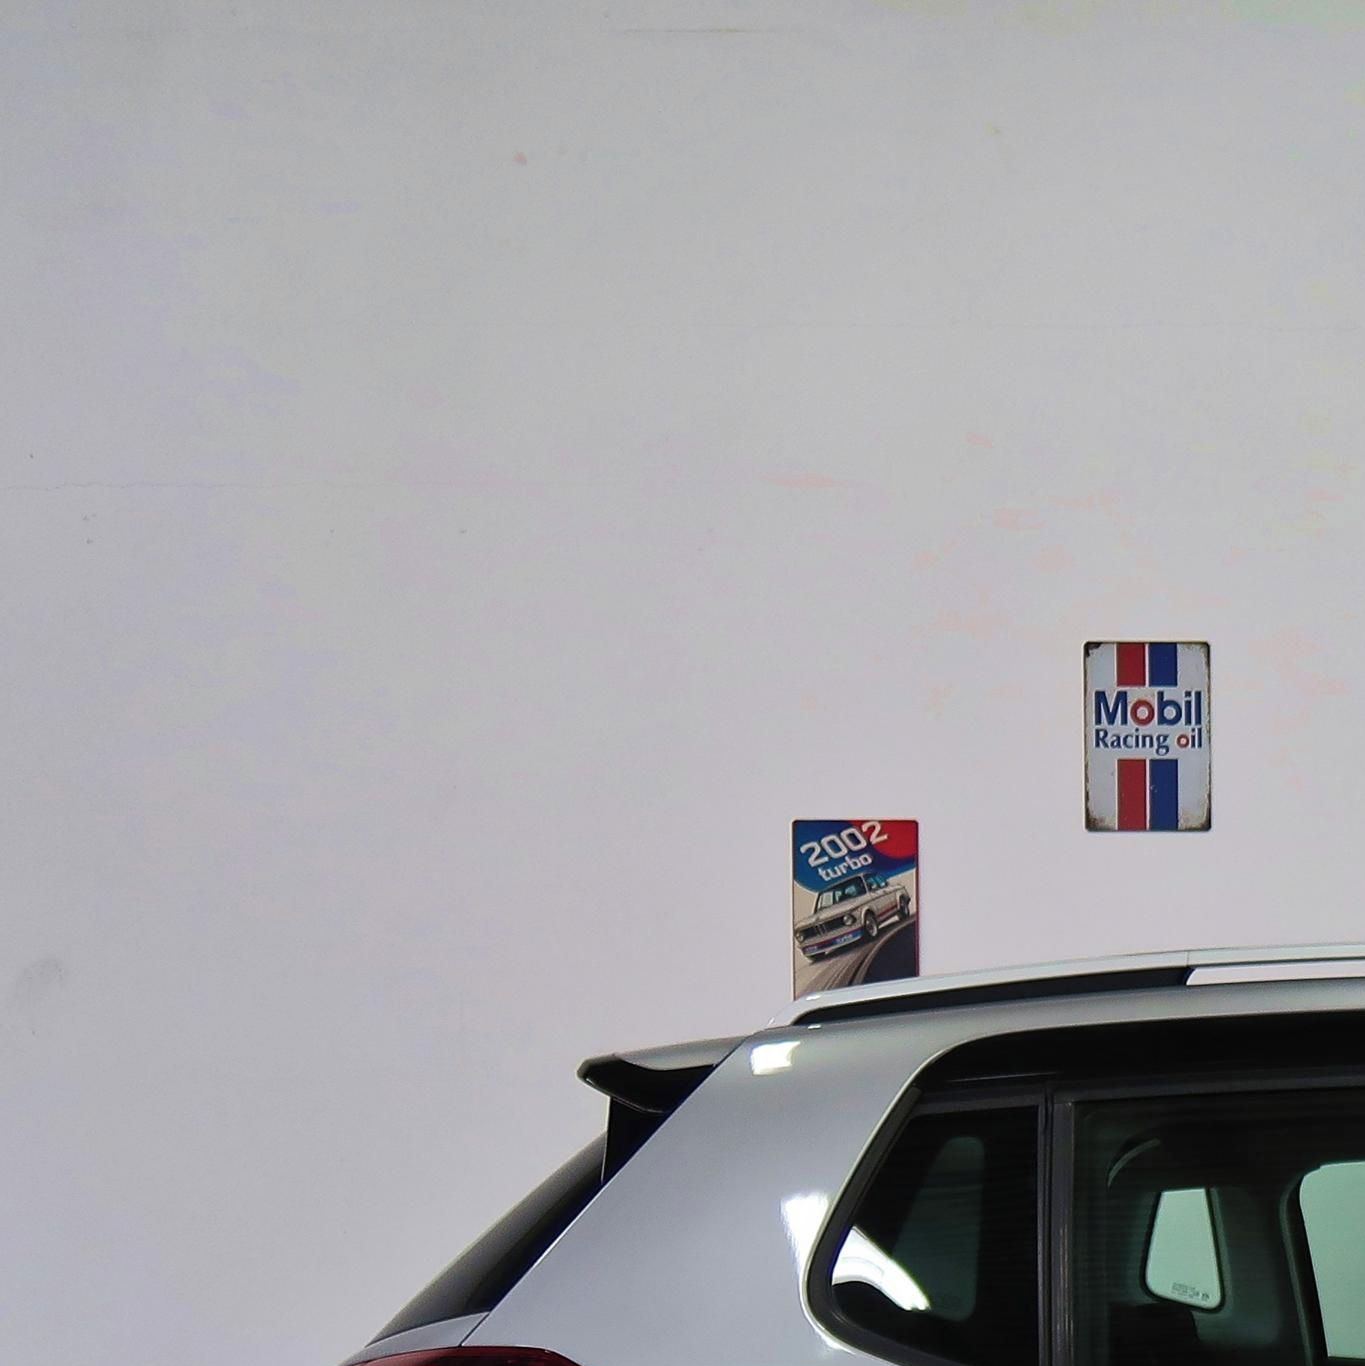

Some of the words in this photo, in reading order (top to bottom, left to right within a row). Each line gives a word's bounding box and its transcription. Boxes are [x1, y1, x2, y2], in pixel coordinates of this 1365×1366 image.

[1094, 690, 1202, 726] Mobil
[1095, 727, 1170, 756] Racing
[1176, 727, 1202, 749] oil
[800, 821, 889, 868] 2002
[818, 853, 873, 882] turbo
